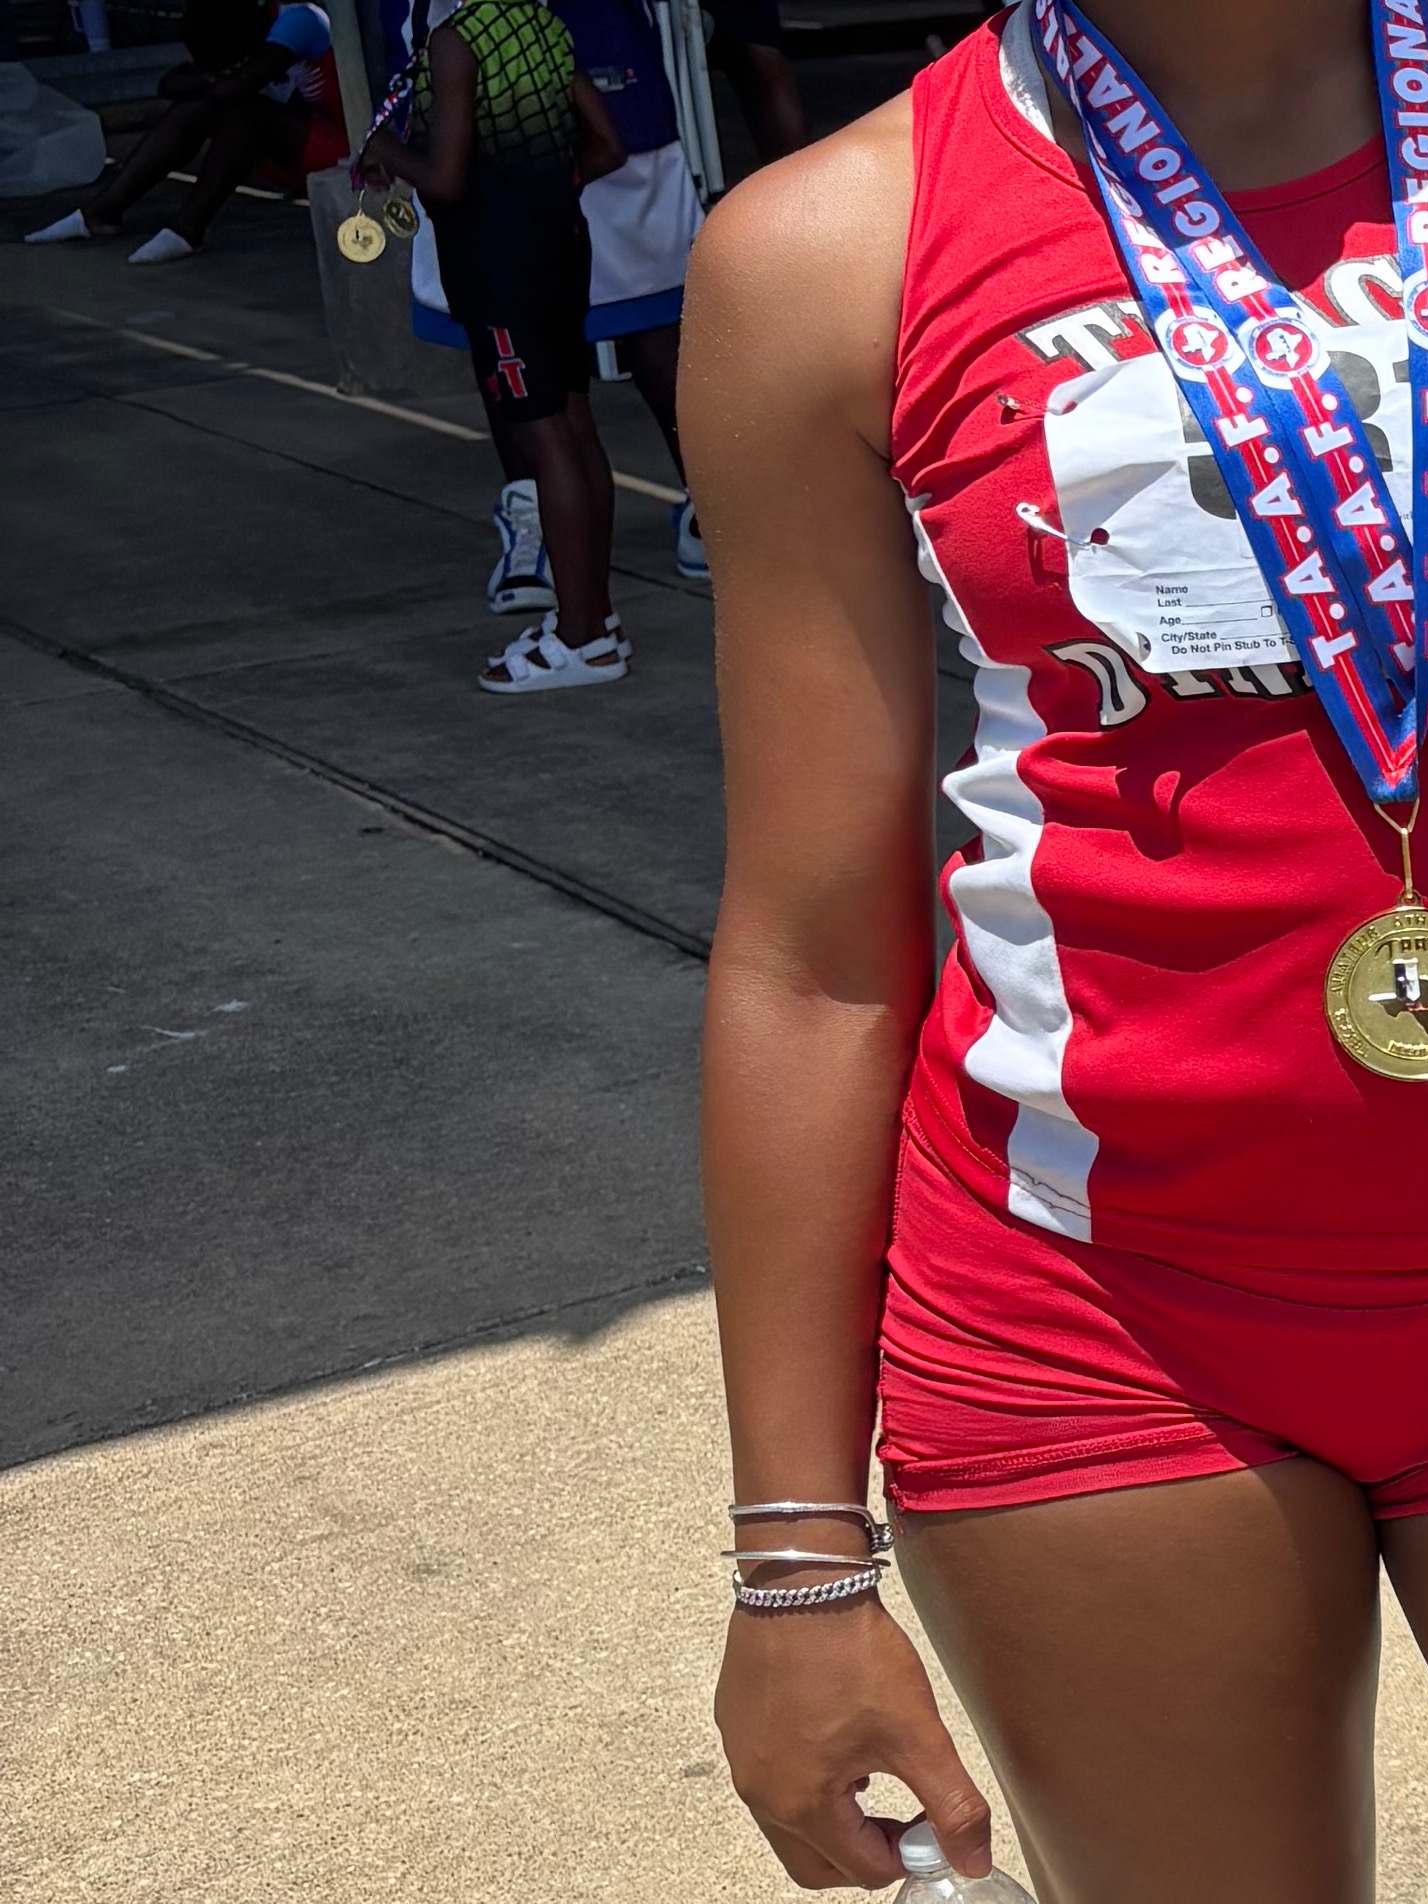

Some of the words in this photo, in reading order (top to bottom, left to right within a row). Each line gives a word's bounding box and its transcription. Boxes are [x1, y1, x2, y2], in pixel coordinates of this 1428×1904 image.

[1214, 385, 1358, 671] T.A.A.F.
[1155, 584, 1189, 596] Name
[1157, 598, 1183, 608] Last
[1159, 616, 1182, 627] Age
[1160, 631, 1218, 645] City/State
[1171, 644, 1188, 656] Do
[1190, 642, 1211, 654] Not
[1213, 641, 1232, 652] Pin
[1234, 639, 1261, 651] Stub
[1262, 638, 1277, 648] To
